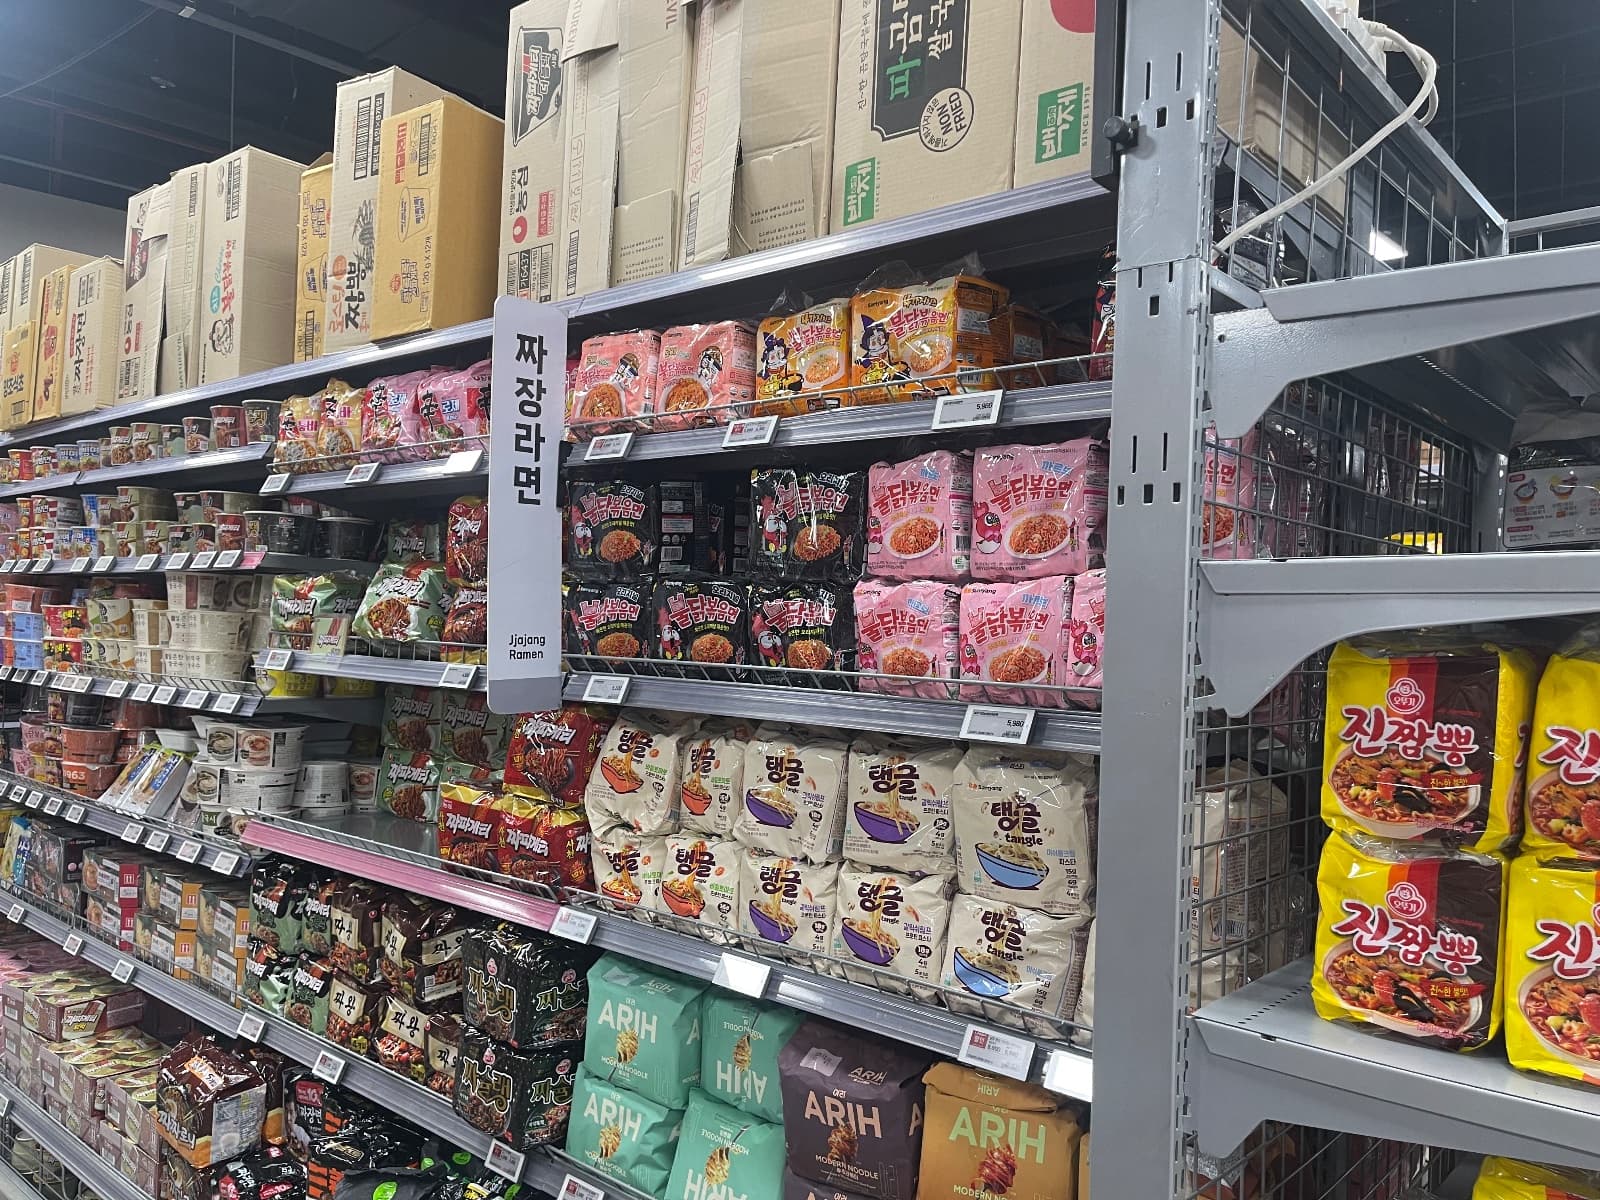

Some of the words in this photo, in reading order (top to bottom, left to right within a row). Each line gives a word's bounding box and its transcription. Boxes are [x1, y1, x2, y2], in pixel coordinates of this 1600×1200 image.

[526, 46, 544, 116] 짜파게티
[936, 103, 953, 136] NON
[948, 91, 968, 133] FRIED
[1040, 87, 1079, 160] 백제
[1081, 112, 1090, 147] SINCE
[516, 166, 529, 214] 농심
[846, 162, 872, 223] 백제
[344, 261, 366, 330] 짬뽕
[888, 308, 950, 341] 불닭볶음면
[441, 398, 460, 414] 로제
[513, 333, 549, 507] 짜장라면
[580, 492, 645, 527] 불닭볶음면
[775, 482, 850, 521] 불닭볶음면
[872, 478, 942, 517] 불닭볶음면
[987, 473, 1076, 517] 불닭볶음면
[711, 584, 741, 604] 오리지널
[578, 597, 641, 631] 불닭볶음면
[667, 592, 741, 630] 불닭볶음면
[859, 607, 930, 645] 불닭볶음면
[967, 606, 1051, 645] 불닭볶음면
[508, 632, 546, 649] Jjajang
[508, 648, 545, 661] Ramen
[390, 695, 434, 718] 짜파게티
[443, 704, 489, 728] 짜파게티
[1392, 694, 1416, 708] 오뚜기
[522, 717, 577, 746] 짜파게티
[617, 729, 654, 759] 탱글
[1339, 704, 1480, 768] 진짬뽕
[387, 763, 431, 783] 짜파게티
[691, 746, 716, 774] 탱글
[765, 755, 805, 787] 탱글
[868, 763, 920, 796] 탱글
[898, 794, 918, 802] tangle
[445, 812, 492, 839] 짜파게티
[990, 801, 1041, 834] 탱글
[506, 828, 549, 857] 짜파게티
[1005, 833, 1044, 849] tangle
[676, 848, 716, 879] 탱글
[759, 865, 802, 900] 탱글
[857, 881, 904, 918] 탱글
[1391, 897, 1416, 913] 오뚜기
[881, 915, 900, 926] tangle
[981, 910, 1027, 953] 탱글
[986, 944, 1025, 962] tangle
[1330, 898, 1482, 977] 진짬뽕
[335, 990, 357, 1017] 짜왕
[468, 966, 518, 1024] 짜슐랭
[536, 980, 587, 1013] 짜슐
[1430, 982, 1452, 997] 진~한
[391, 1009, 420, 1039] 짜왕
[596, 999, 658, 1045] ARIH
[722, 1020, 745, 1032] NOODLE
[461, 1056, 513, 1115] 짜슐랭
[623, 1066, 649, 1080] NOODLE
[715, 1059, 769, 1105] ARIH
[847, 1065, 888, 1083] ARIH
[831, 1087, 847, 1099] 아리
[976, 1083, 1001, 1097] ARIH
[583, 1092, 643, 1142] ARIH
[803, 1089, 882, 1139] ARIH
[701, 1127, 724, 1144] NOODLE
[947, 1105, 1048, 1165] ARIH
[815, 1153, 846, 1172] MODERN
[846, 1164, 879, 1181] NOODLE
